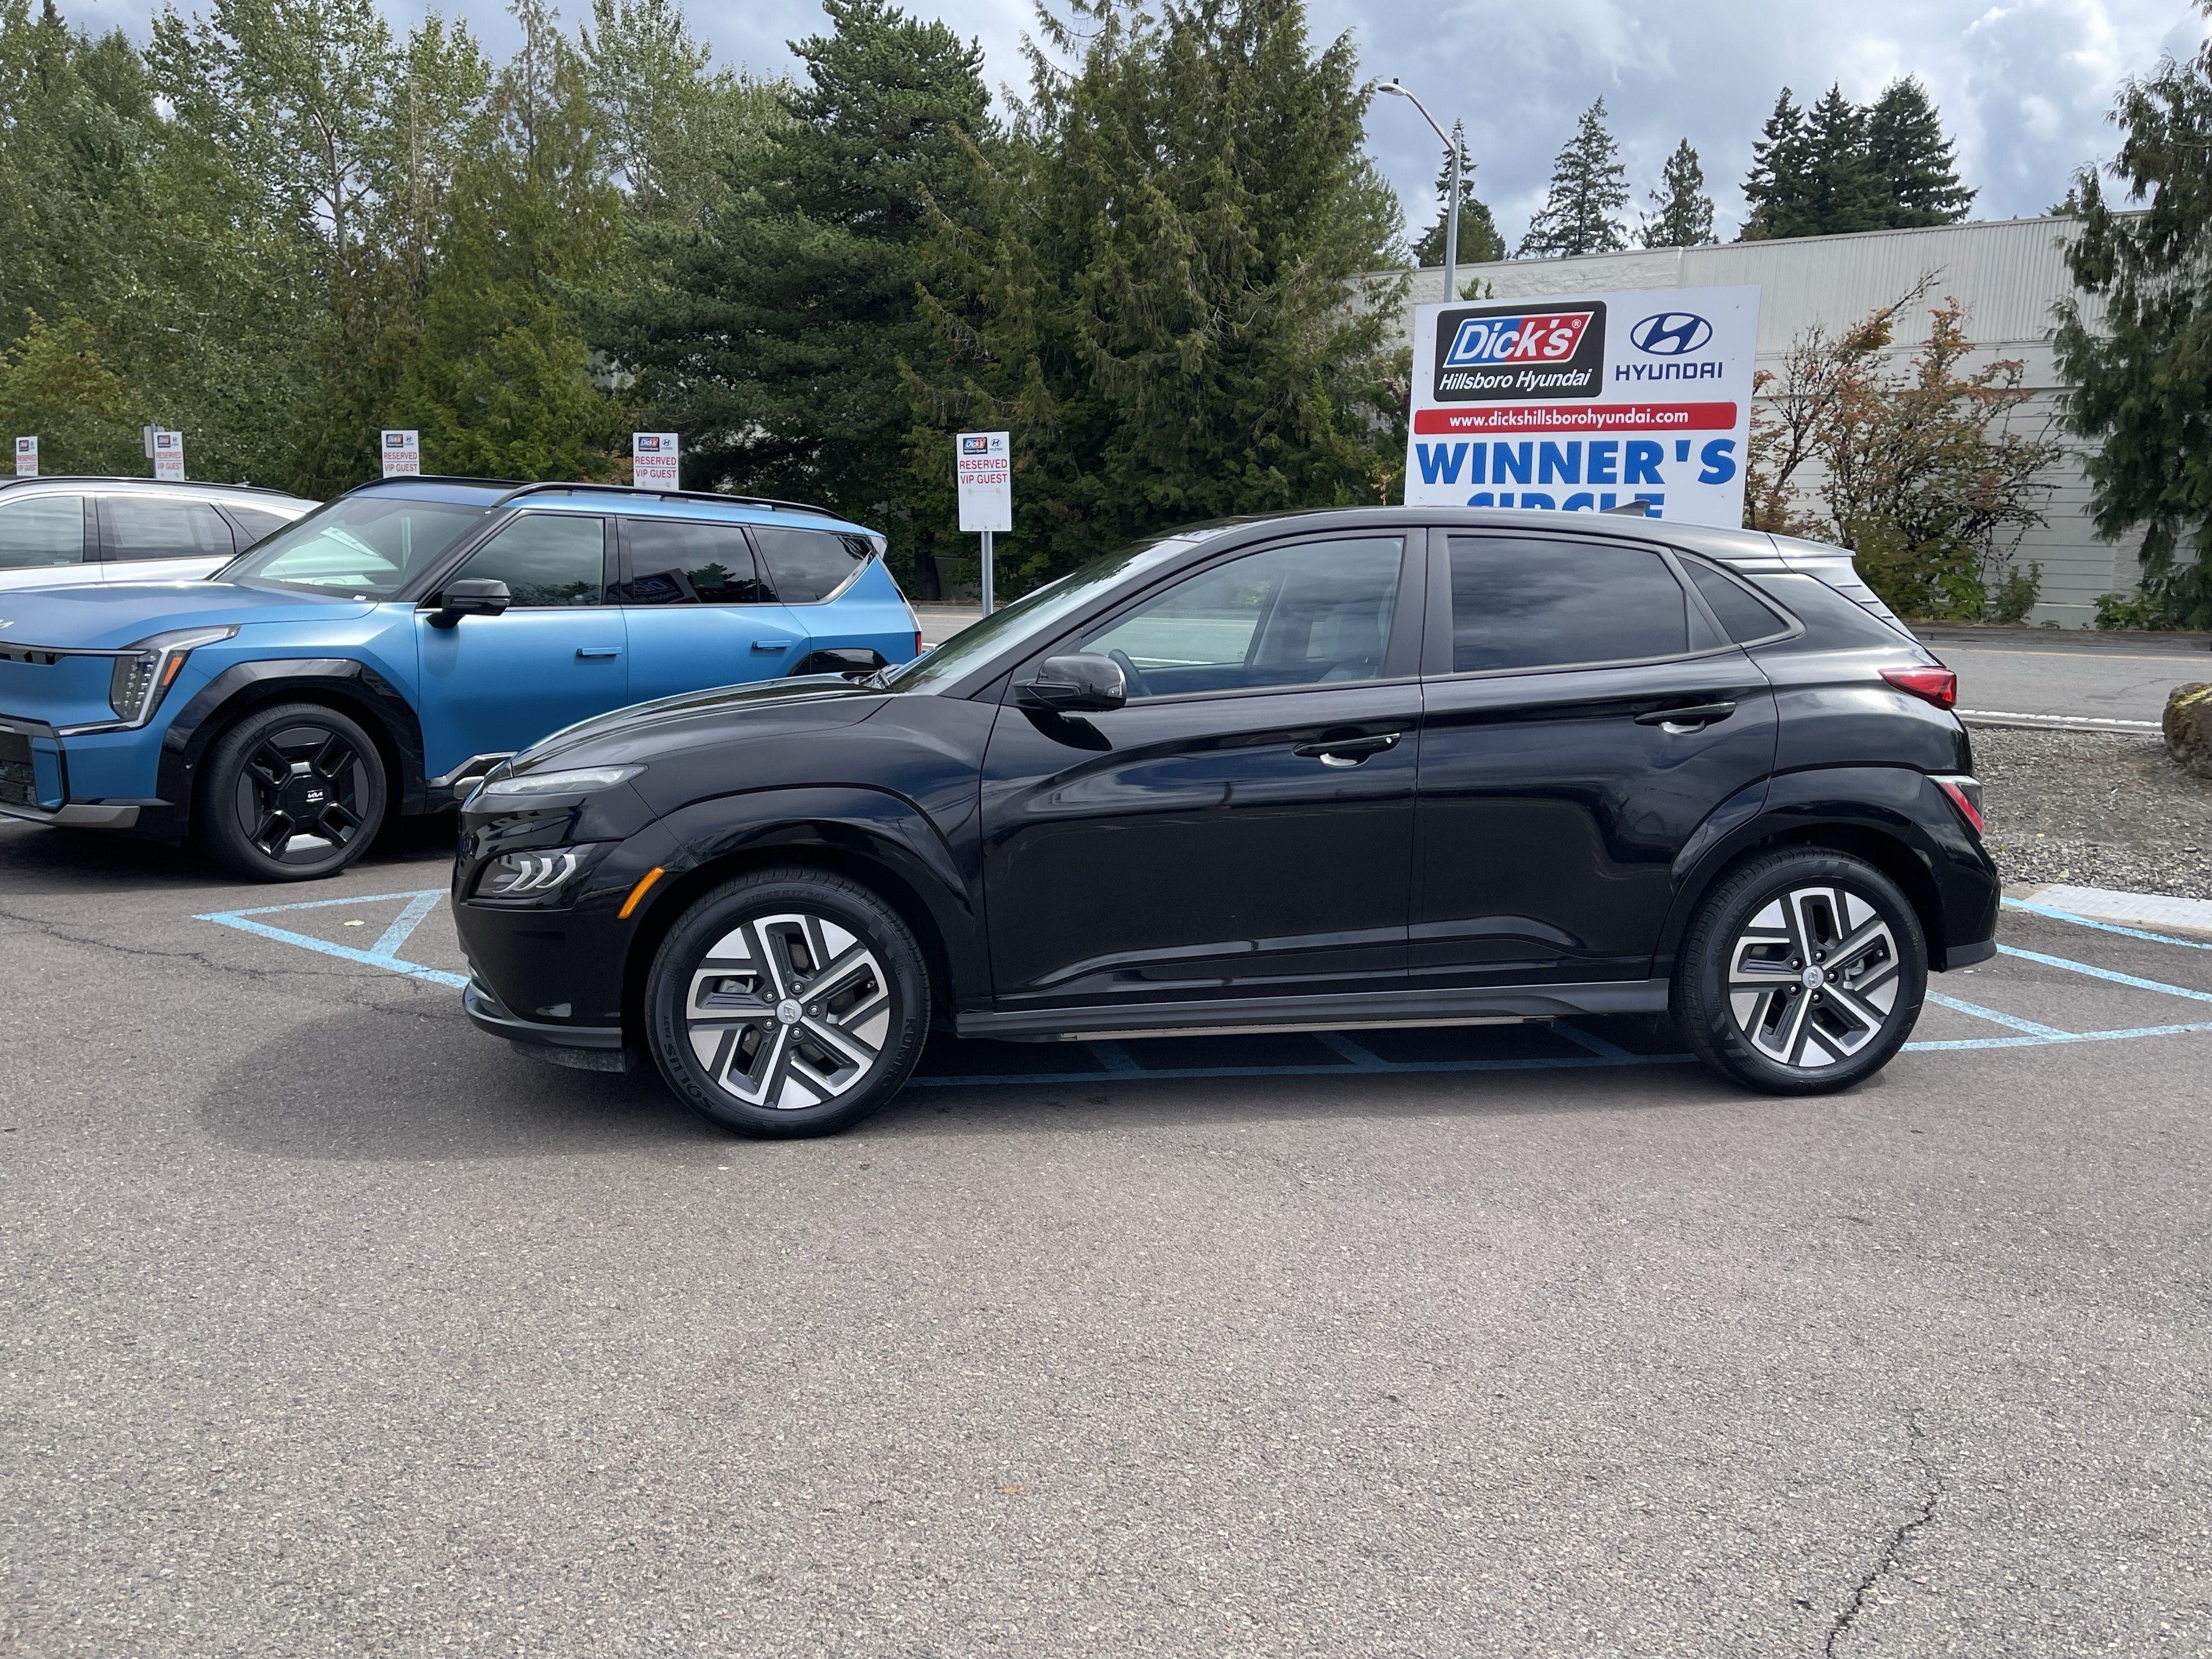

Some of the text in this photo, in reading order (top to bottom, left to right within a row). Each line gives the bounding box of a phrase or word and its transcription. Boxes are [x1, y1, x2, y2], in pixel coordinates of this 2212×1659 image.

[1615, 362, 1723, 381] HYUNDAI
[1439, 369, 1593, 391] Hillsboro Hyundai
[1449, 408, 1689, 428] www.dickshillsborohyundai.com
[635, 456, 676, 465] RESERVED
[959, 459, 1007, 470] RESERVED
[1415, 438, 1737, 484] WINNER'S
[650, 470, 676, 478] GUEST
[960, 473, 1007, 484] VIP GUEST
